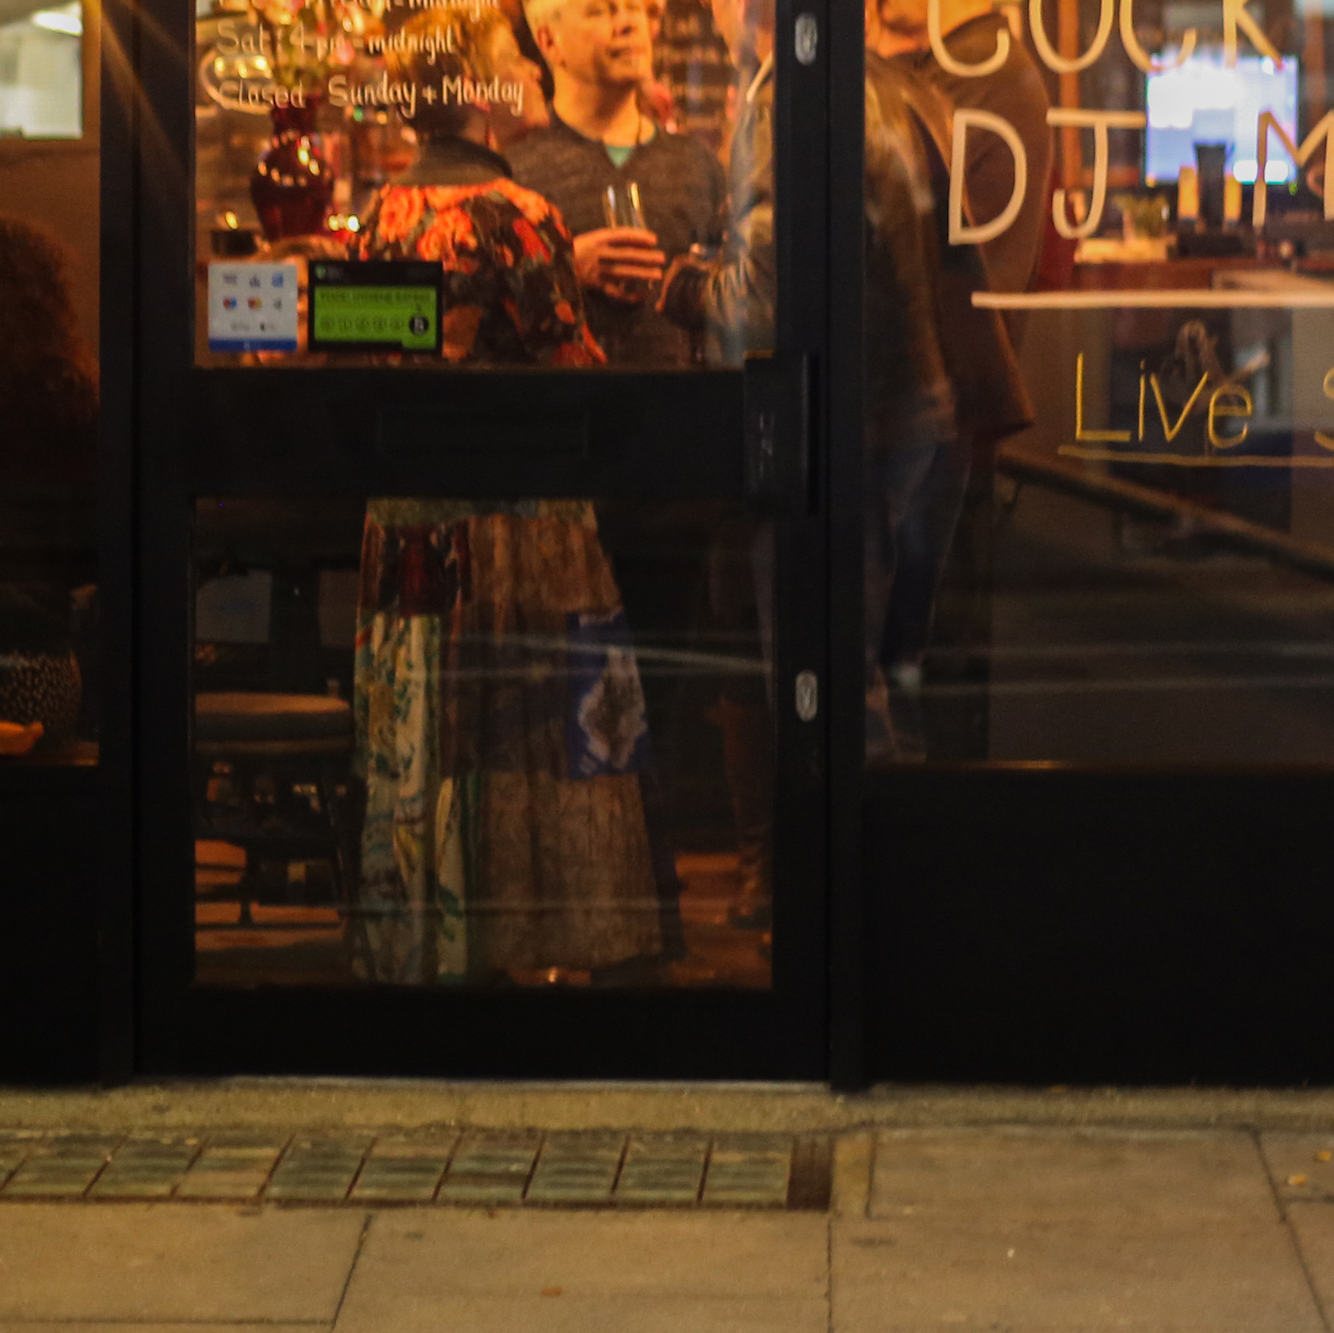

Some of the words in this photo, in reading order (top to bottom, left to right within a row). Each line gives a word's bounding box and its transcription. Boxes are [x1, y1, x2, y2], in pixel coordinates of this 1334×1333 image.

[328, 70, 417, 118] Sunday
[442, 74, 525, 117] Monday
[947, 106, 1147, 246] DJ
[1075, 351, 1253, 448] Live
